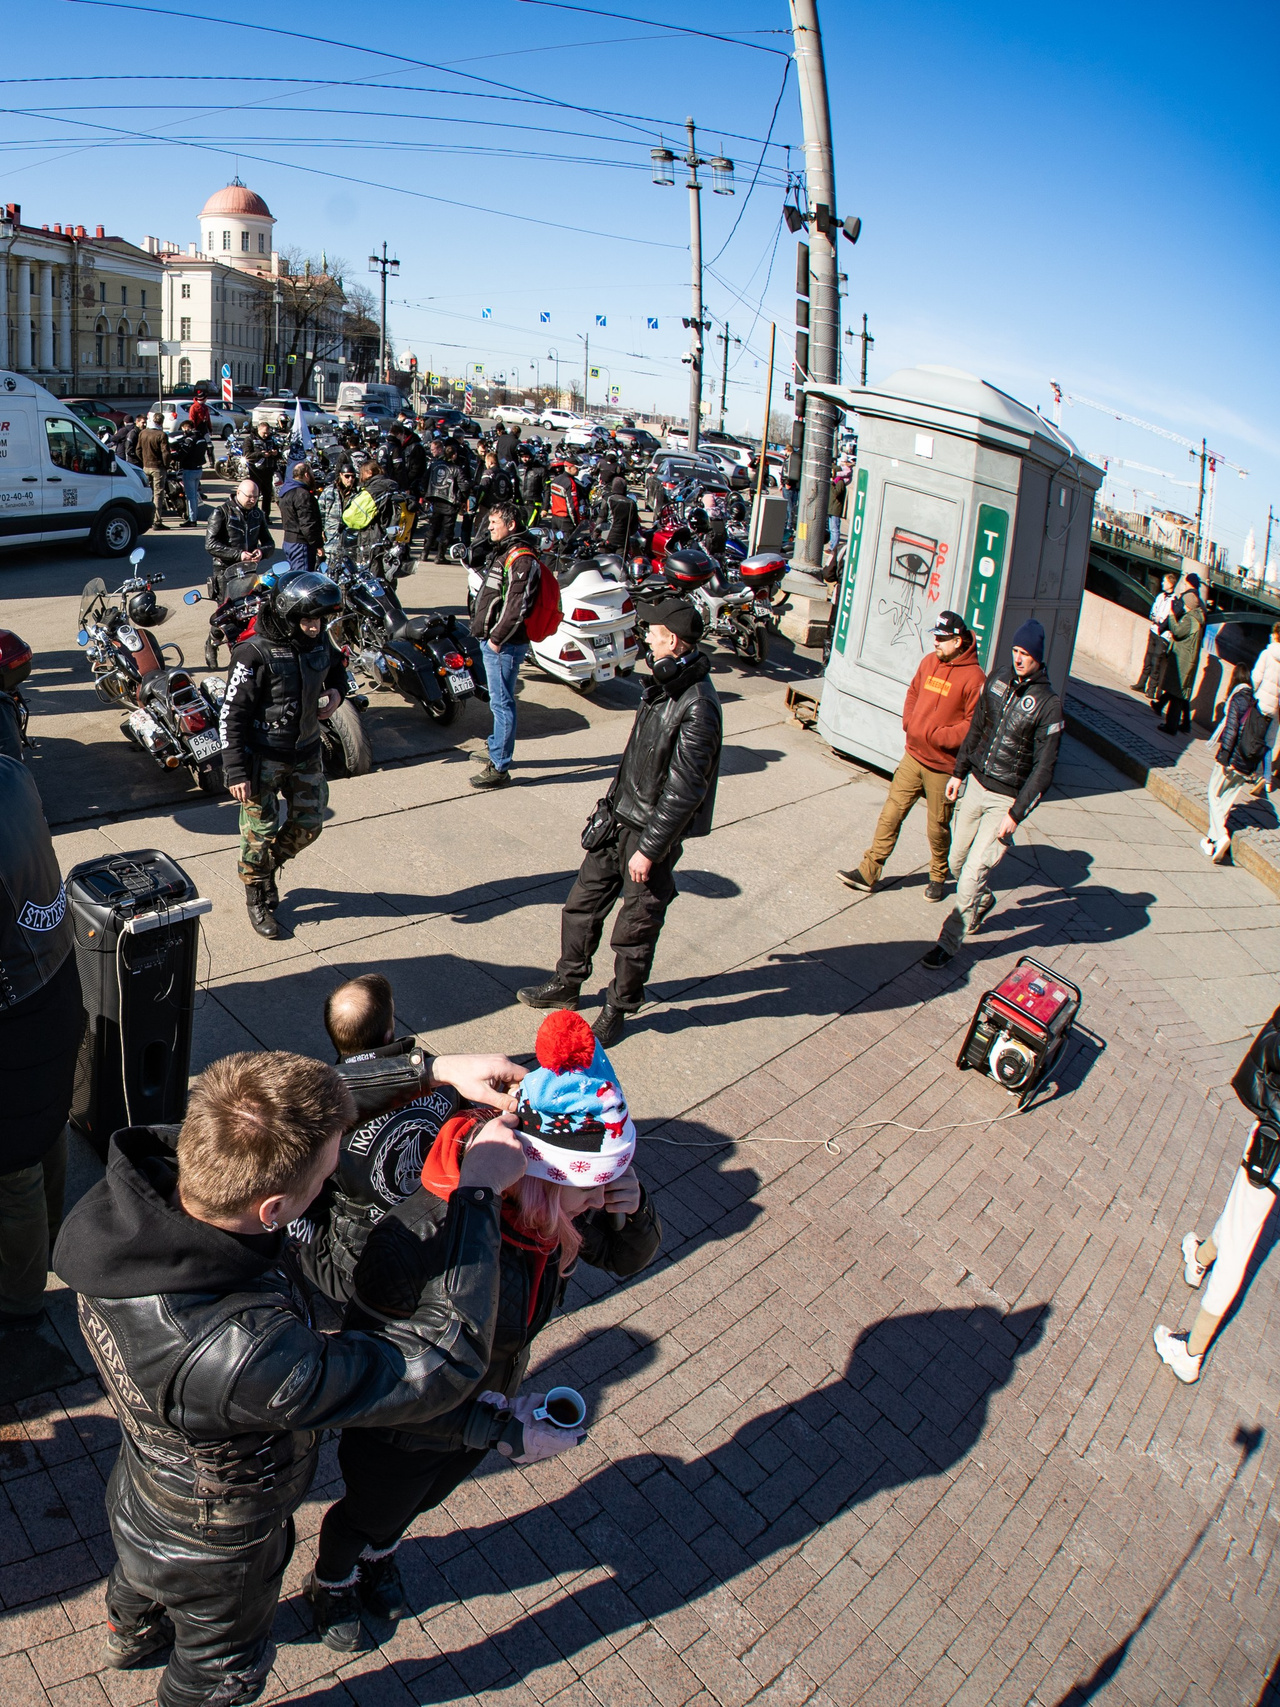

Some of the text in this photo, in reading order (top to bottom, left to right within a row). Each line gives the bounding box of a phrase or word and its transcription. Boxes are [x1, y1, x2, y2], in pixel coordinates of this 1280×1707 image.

[927, 542, 949, 602] OPEN
[972, 529, 999, 656] TOILE
[193, 730, 214, 746] 8568
[252, 700, 299, 731] RUSSIA
[87, 1313, 141, 1405] RIDERS
